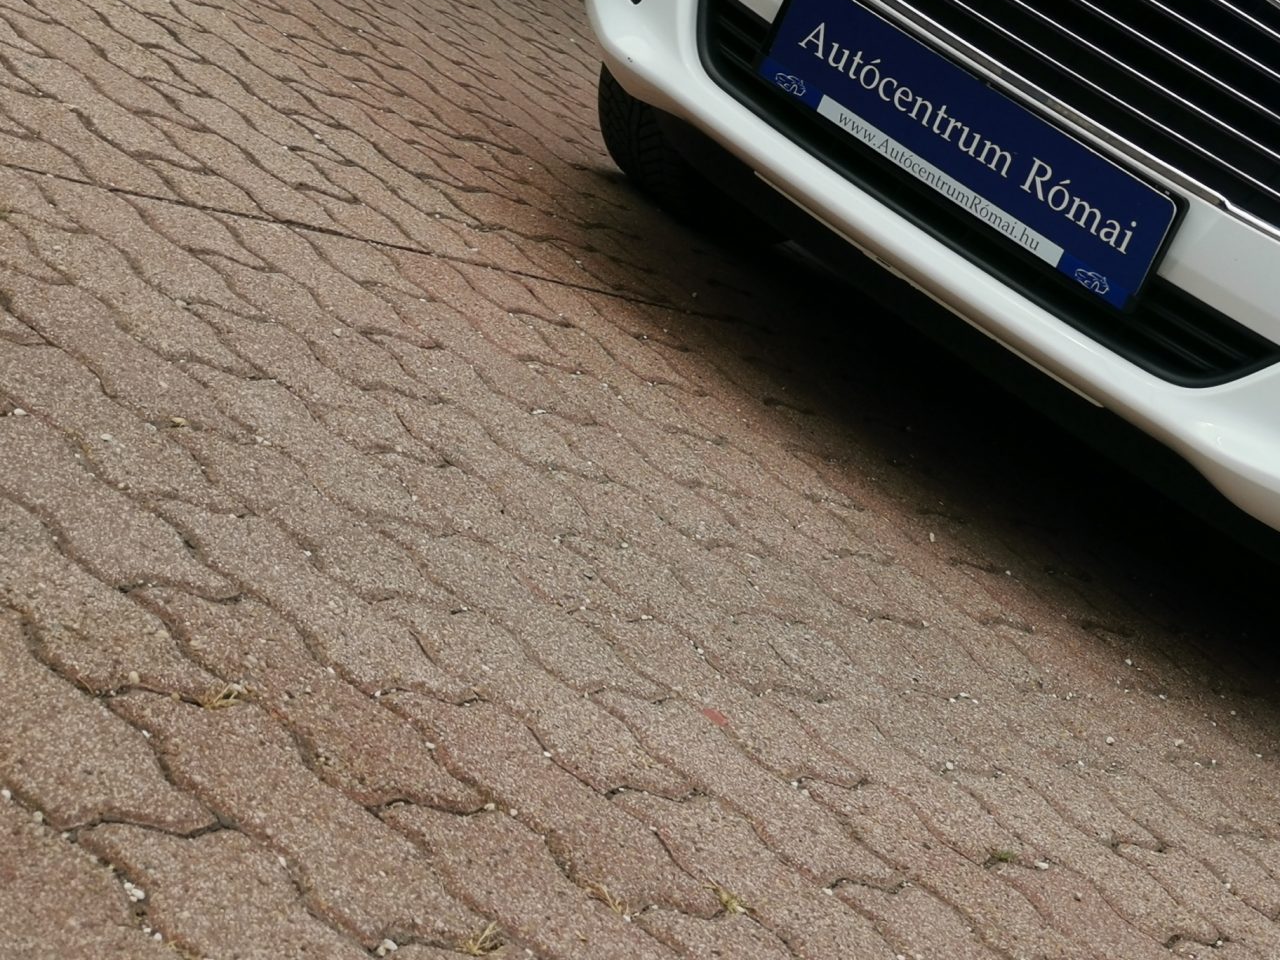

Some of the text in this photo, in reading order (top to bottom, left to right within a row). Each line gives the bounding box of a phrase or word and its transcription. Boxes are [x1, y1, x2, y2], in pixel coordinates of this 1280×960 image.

[798, 21, 1138, 255] Autócentrum Római
[838, 111, 1040, 252] www.AutócentrumRómai.hu
